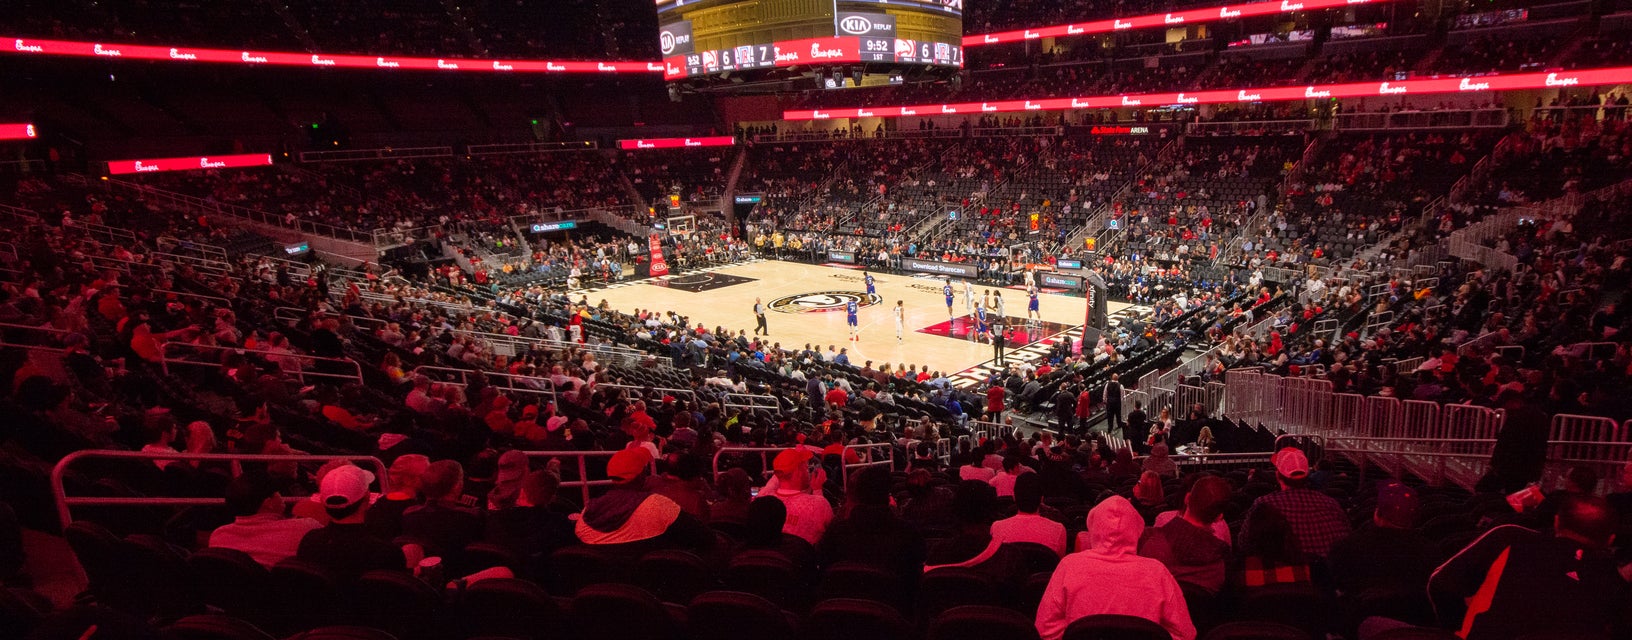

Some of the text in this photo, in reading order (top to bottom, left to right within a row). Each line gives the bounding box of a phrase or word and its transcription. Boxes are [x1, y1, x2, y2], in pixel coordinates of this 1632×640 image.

[845, 20, 892, 31] KIA REPLAY
[866, 40, 888, 51] 9:52
[922, 43, 929, 58] 6
[722, 51, 730, 65] 6
[759, 46, 767, 61] 7
[952, 47, 958, 61] 7
[912, 262, 966, 274] Download Sharecare
[1088, 284, 1097, 309] xfinity
